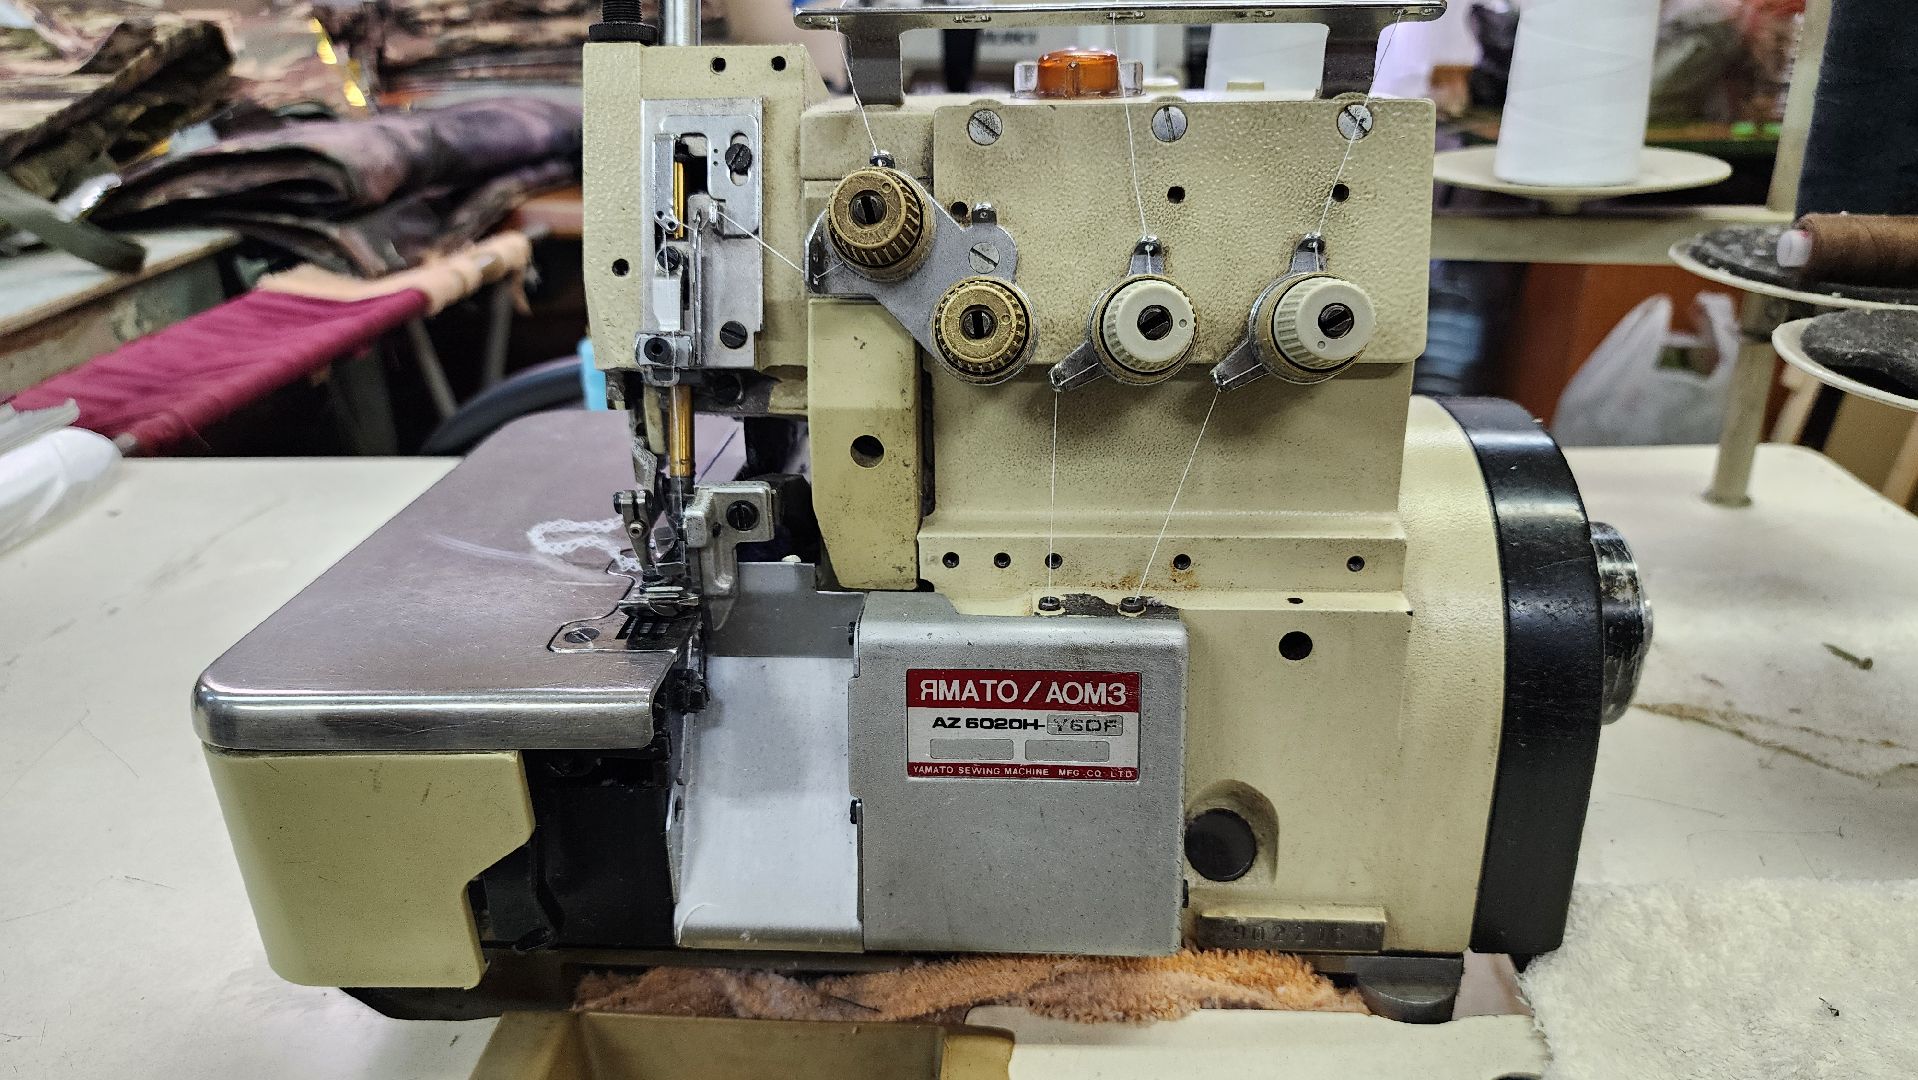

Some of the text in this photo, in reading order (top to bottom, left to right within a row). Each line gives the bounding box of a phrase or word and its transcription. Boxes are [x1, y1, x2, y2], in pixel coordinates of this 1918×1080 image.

[932, 717, 961, 729] AZ
[913, 765, 954, 774] YAMATO
[958, 766, 1001, 776] SEWING
[1004, 767, 1050, 776] MACHINE
